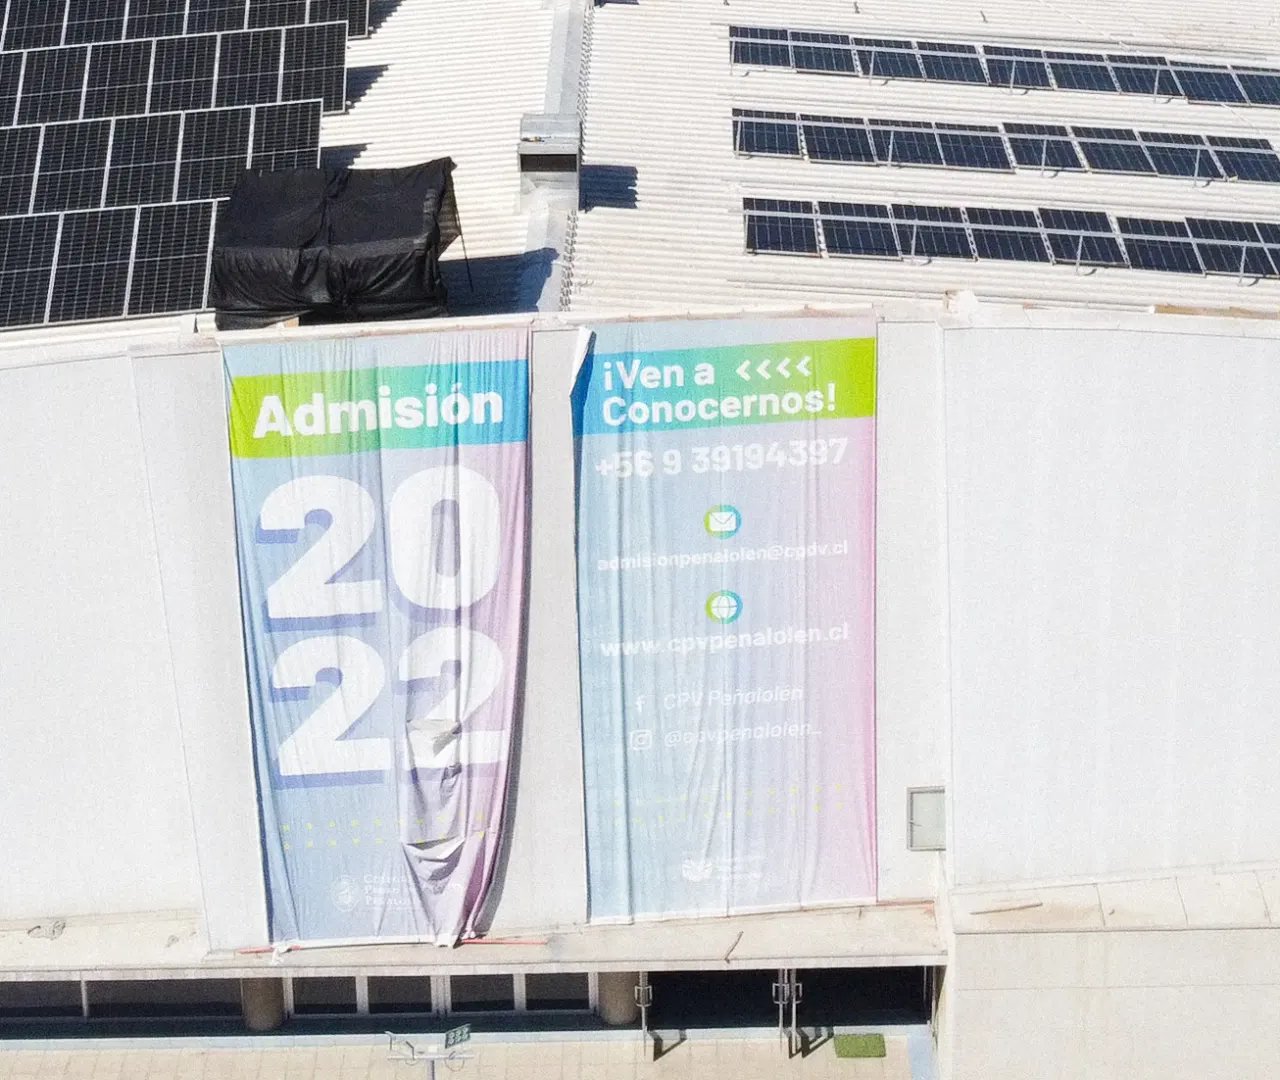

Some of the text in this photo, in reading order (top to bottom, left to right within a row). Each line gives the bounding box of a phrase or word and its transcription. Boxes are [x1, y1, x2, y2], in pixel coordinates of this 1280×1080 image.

[694, 362, 716, 386] a
[253, 383, 504, 439] Admisión
[602, 381, 836, 427] Conocernos!
[595, 437, 848, 480] +56 9 39194397
[260, 465, 501, 619] 20
[272, 626, 508, 776] 22
